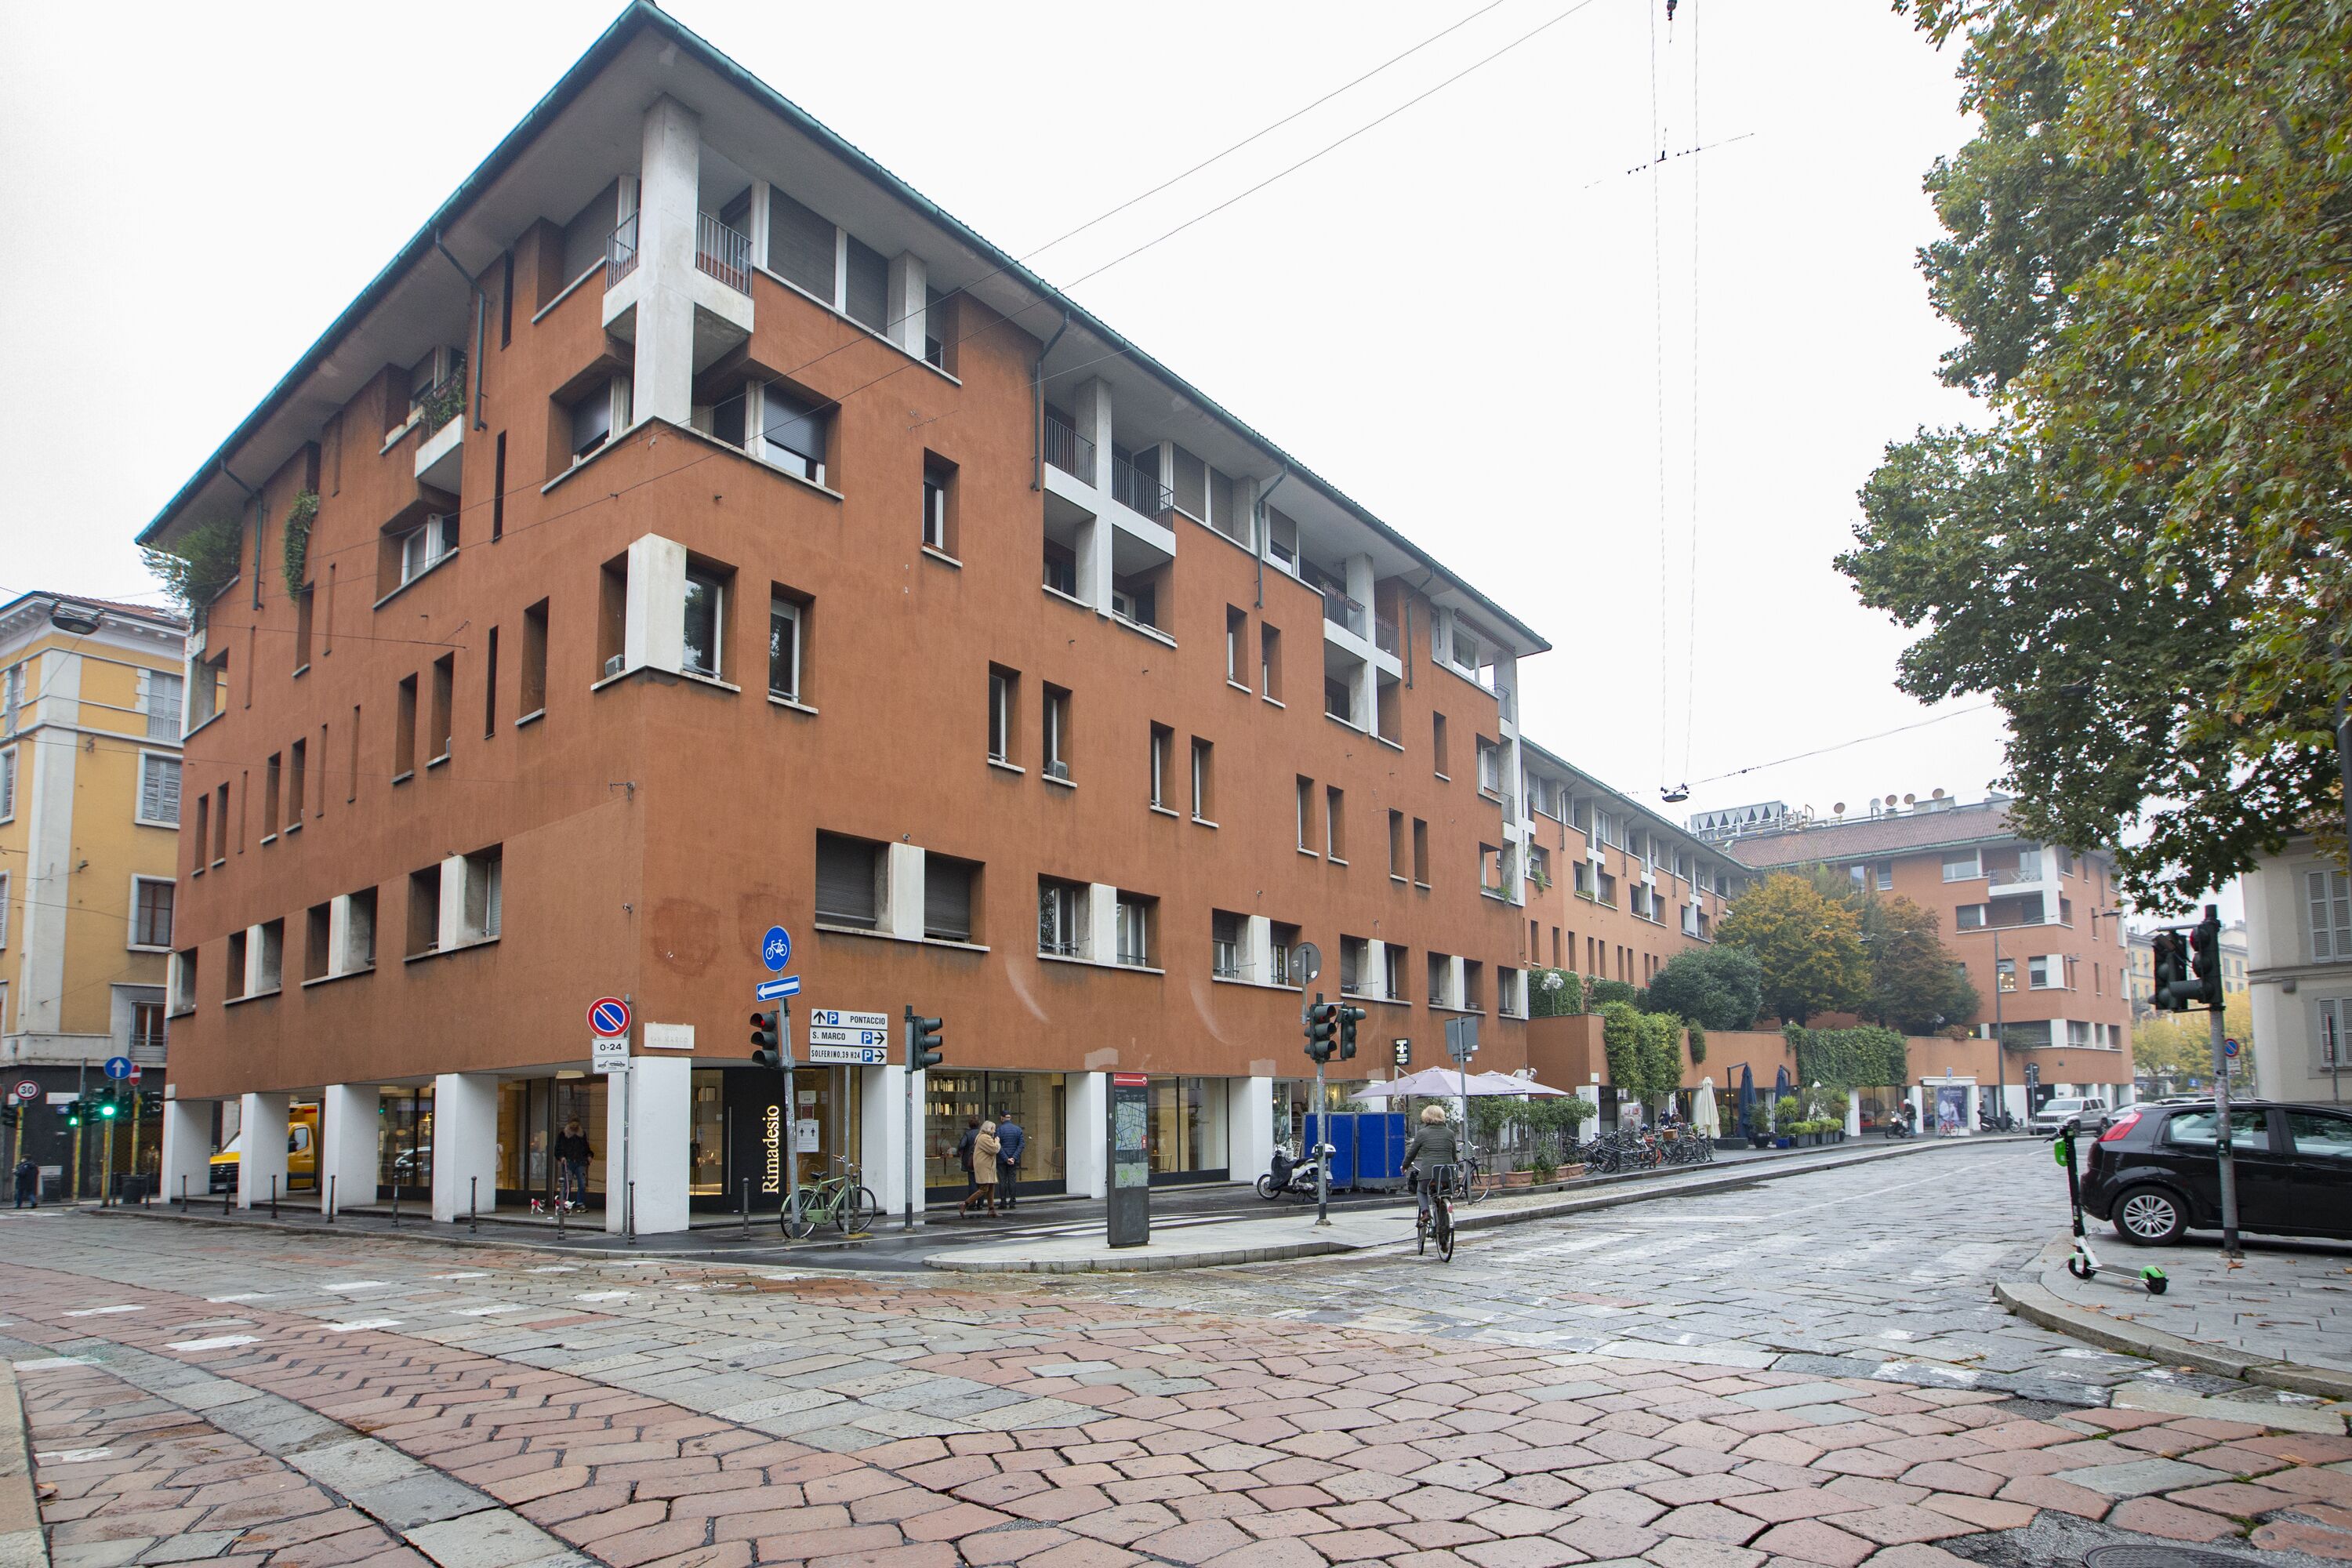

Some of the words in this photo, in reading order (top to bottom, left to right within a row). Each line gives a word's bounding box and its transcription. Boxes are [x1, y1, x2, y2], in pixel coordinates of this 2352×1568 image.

[850, 1015, 885, 1025] PONTACCIO
[812, 1031, 819, 1040] S.
[822, 1032, 846, 1040] MARCO
[600, 1043, 622, 1051] 0-24
[20, 1086, 34, 1094] 30
[762, 1105, 779, 1194] Rimadesio
